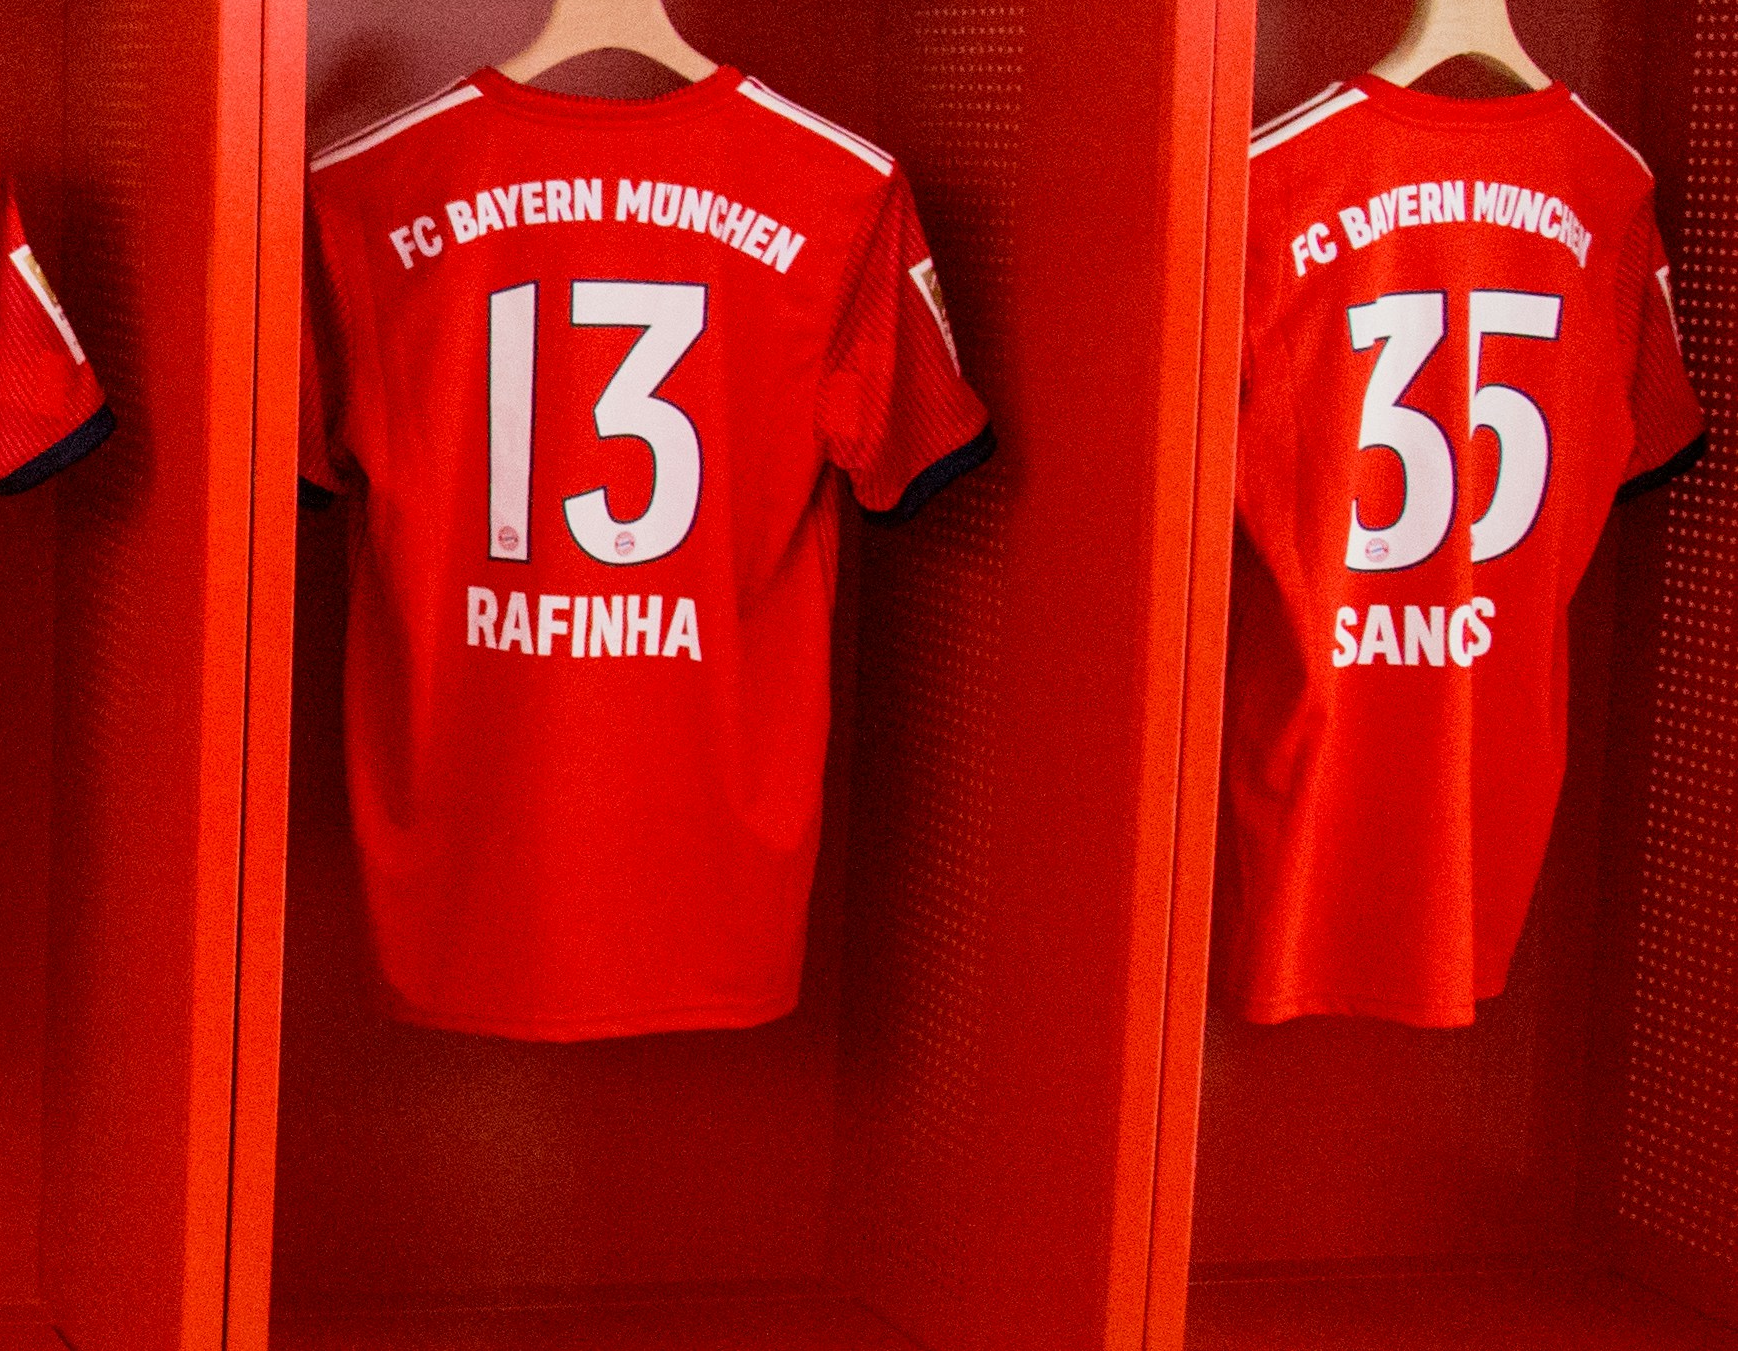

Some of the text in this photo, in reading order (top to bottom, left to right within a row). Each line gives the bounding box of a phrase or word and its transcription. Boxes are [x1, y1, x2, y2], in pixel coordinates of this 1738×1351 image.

[390, 217, 442, 268] FC
[446, 179, 602, 243] BAYERN
[1292, 223, 1337, 276] FC
[1338, 180, 1465, 249] BAYERN
[489, 280, 706, 565] 13
[1342, 289, 1562, 572] 35
[468, 587, 701, 661] RAFINHA
